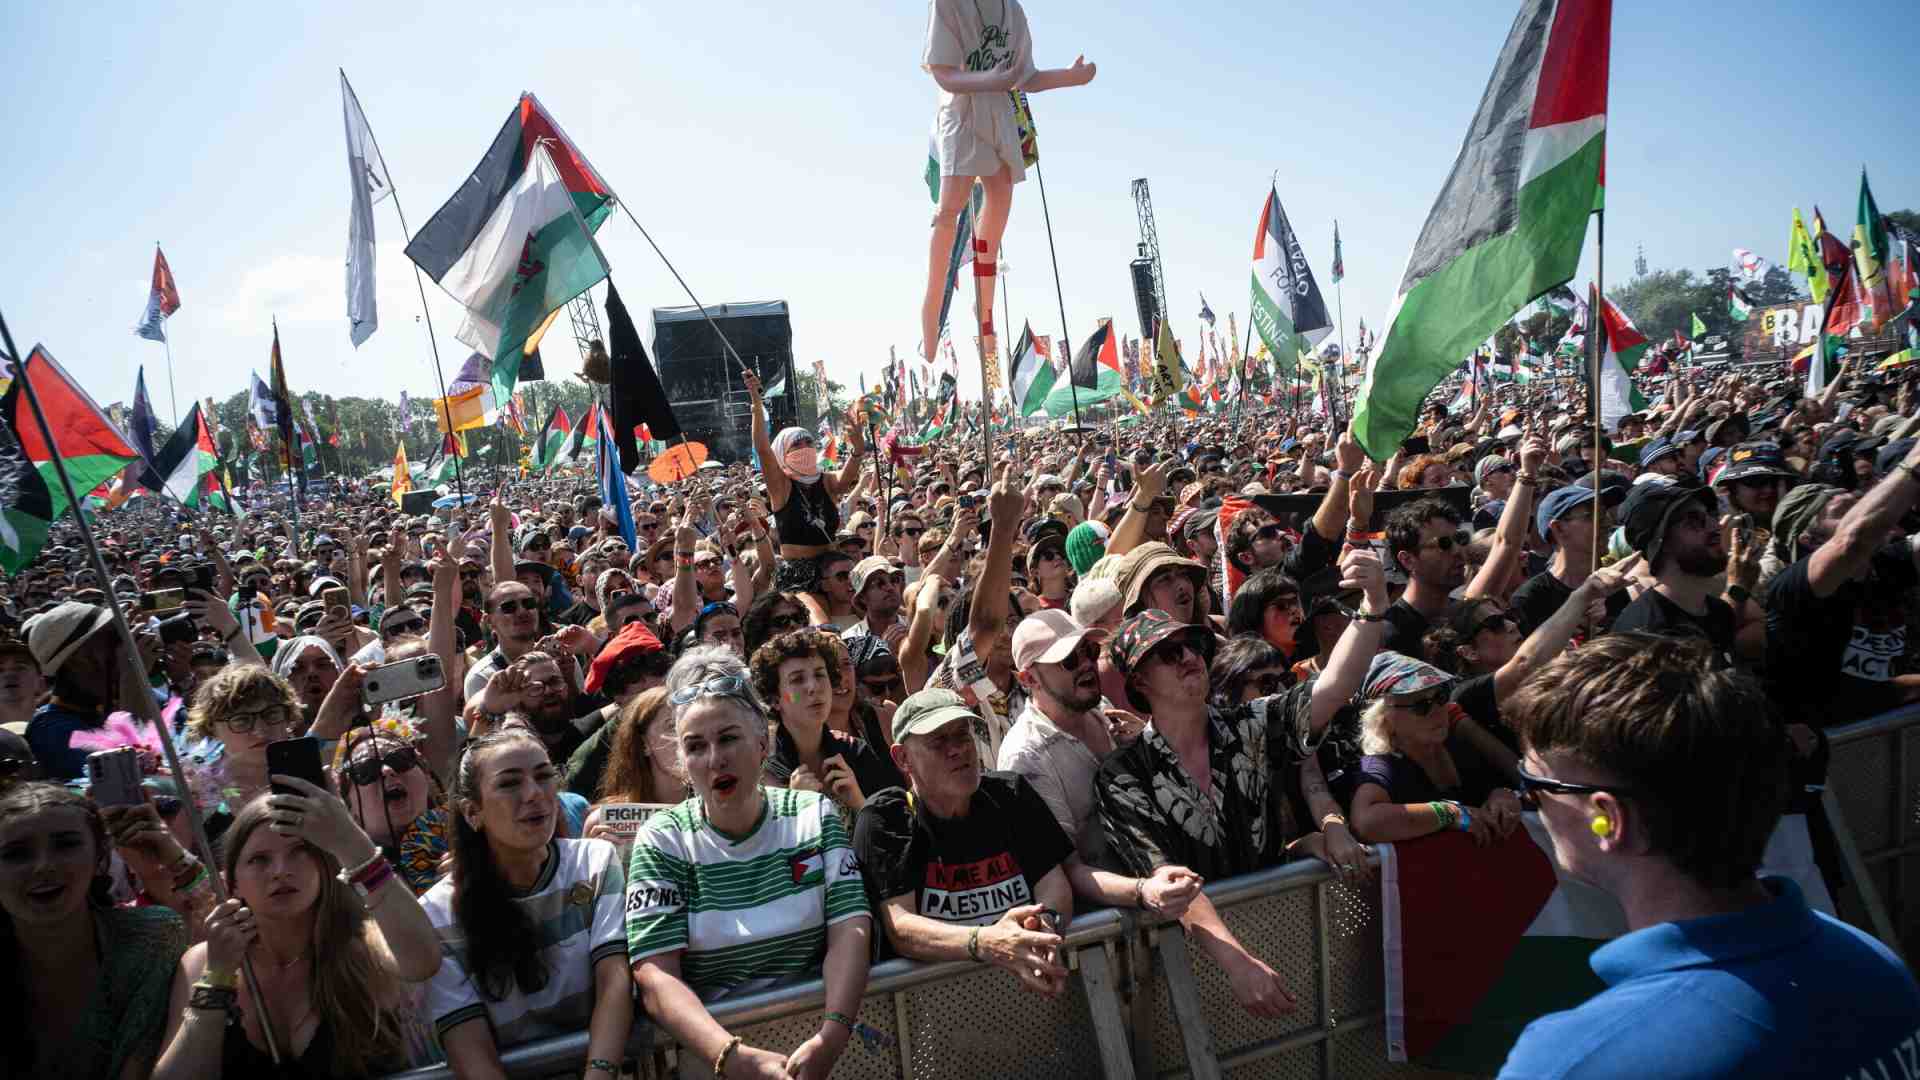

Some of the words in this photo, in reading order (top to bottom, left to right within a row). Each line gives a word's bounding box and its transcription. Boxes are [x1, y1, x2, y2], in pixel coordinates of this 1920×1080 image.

[1250, 289, 1289, 348] LESTINE
[606, 808, 650, 821] FIGHT
[627, 888, 681, 912] ESTNE
